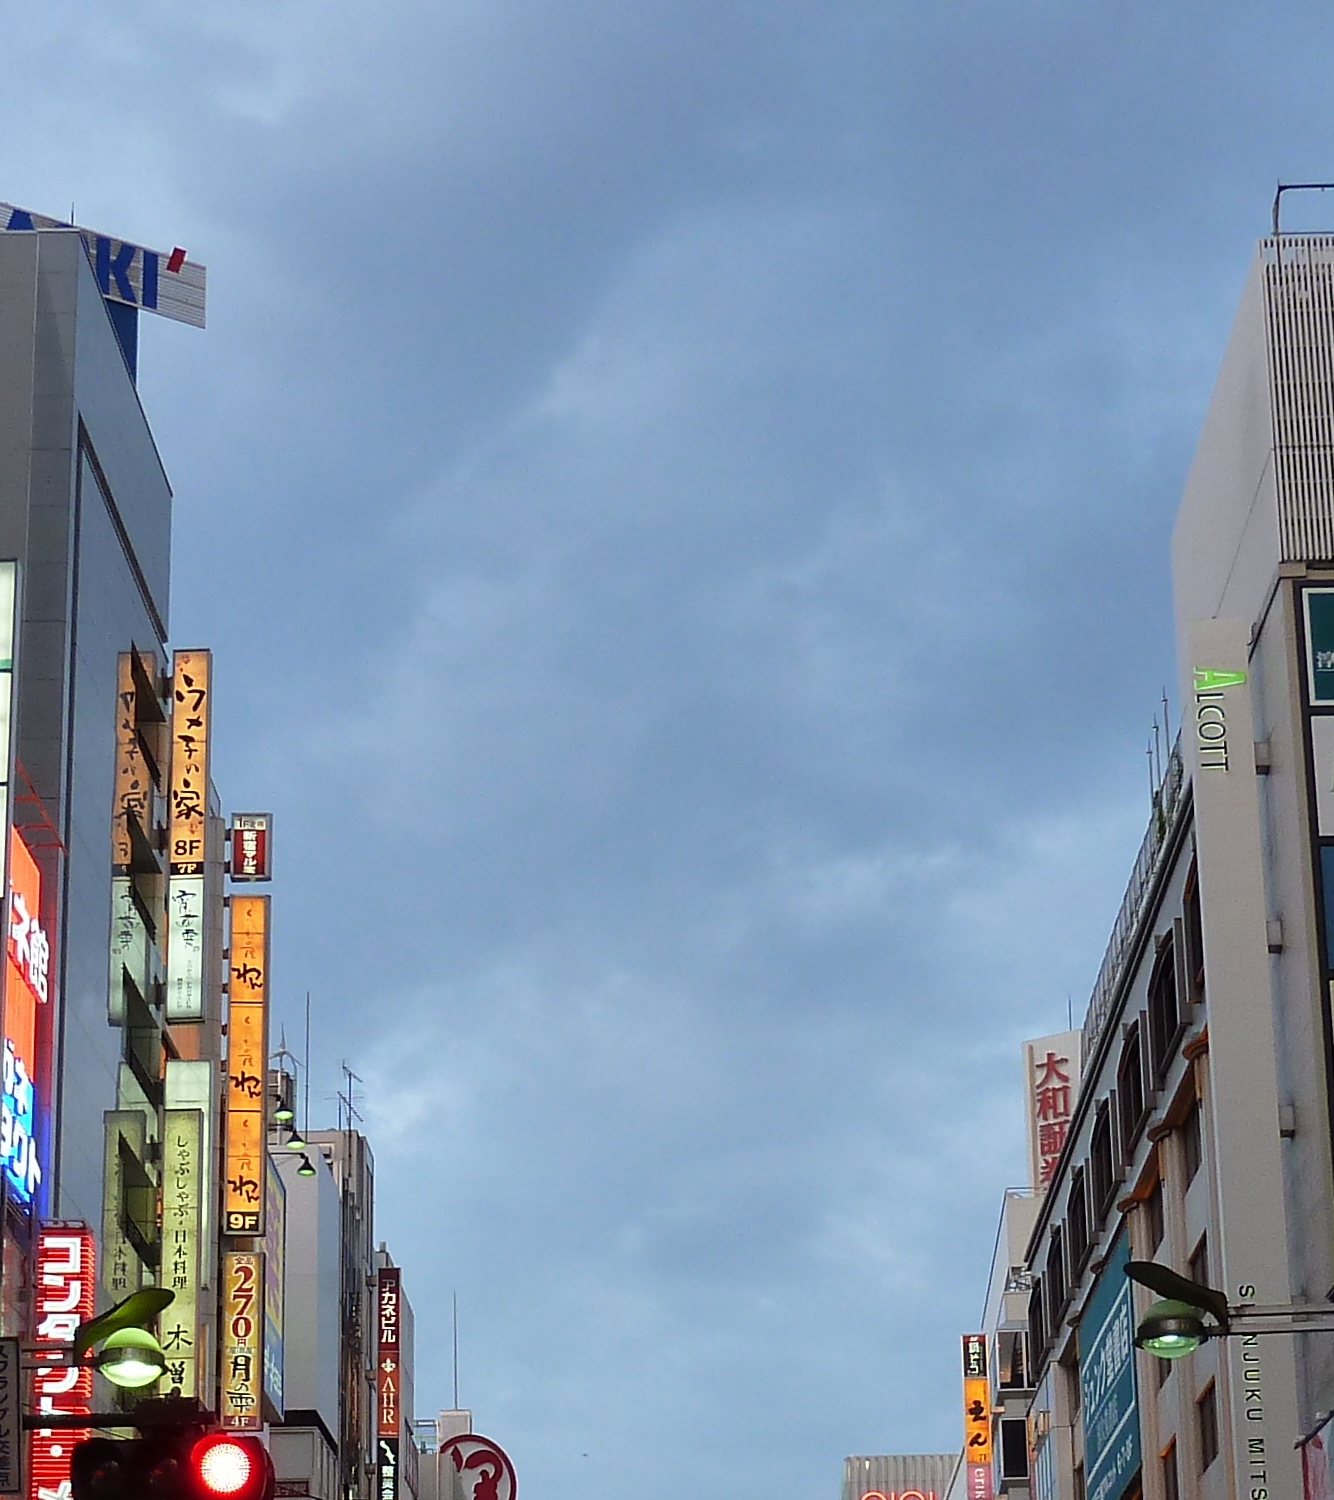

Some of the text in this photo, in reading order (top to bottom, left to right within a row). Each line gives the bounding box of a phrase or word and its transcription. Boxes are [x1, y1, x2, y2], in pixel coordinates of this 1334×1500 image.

[174, 840, 202, 856] 8F
[178, 863, 198, 875] 7F
[228, 1212, 258, 1230] 9F
[379, 1278, 397, 1344] アカネビル
[230, 1415, 251, 1427] 4F
